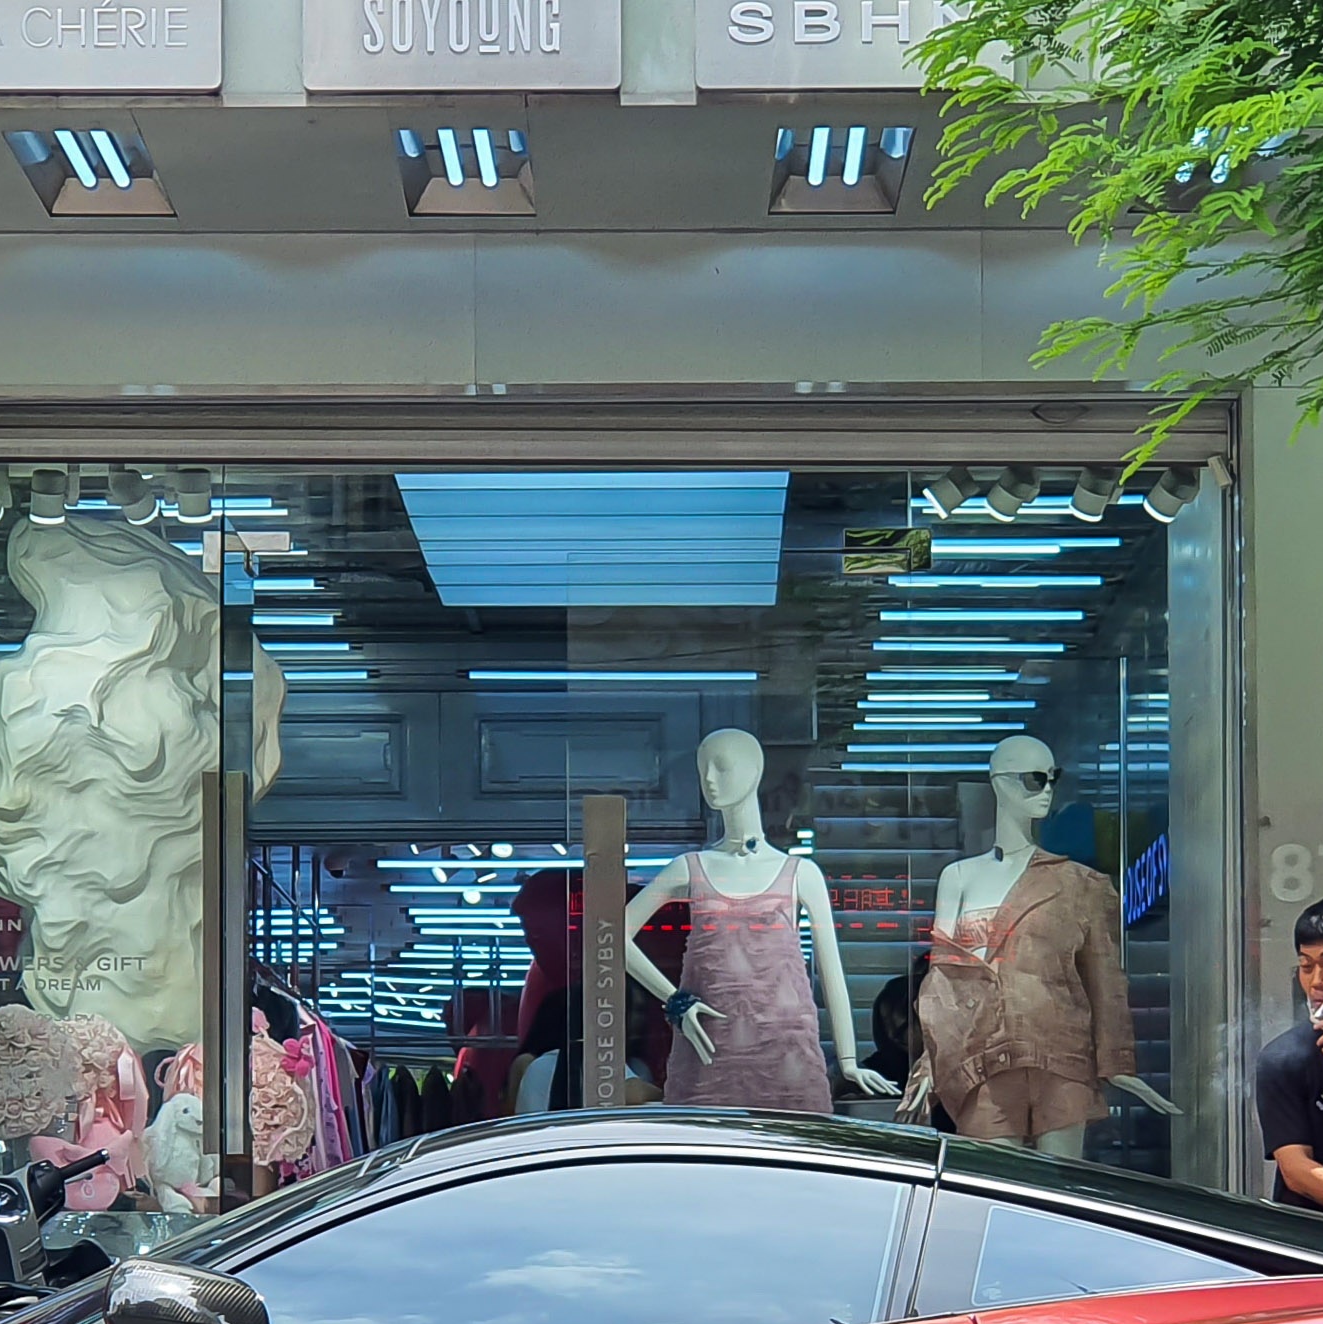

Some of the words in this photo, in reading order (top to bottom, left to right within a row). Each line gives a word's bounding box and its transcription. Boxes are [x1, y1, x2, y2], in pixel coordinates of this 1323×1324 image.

[21, 0, 189, 48] CHÉRIE
[363, 0, 561, 53] SOYOUNG
[96, 956, 147, 972] GIFT
[597, 918, 614, 988] SYBSY
[14, 978, 27, 991] A
[35, 978, 102, 991] DREAM
[597, 998, 614, 1028] OF
